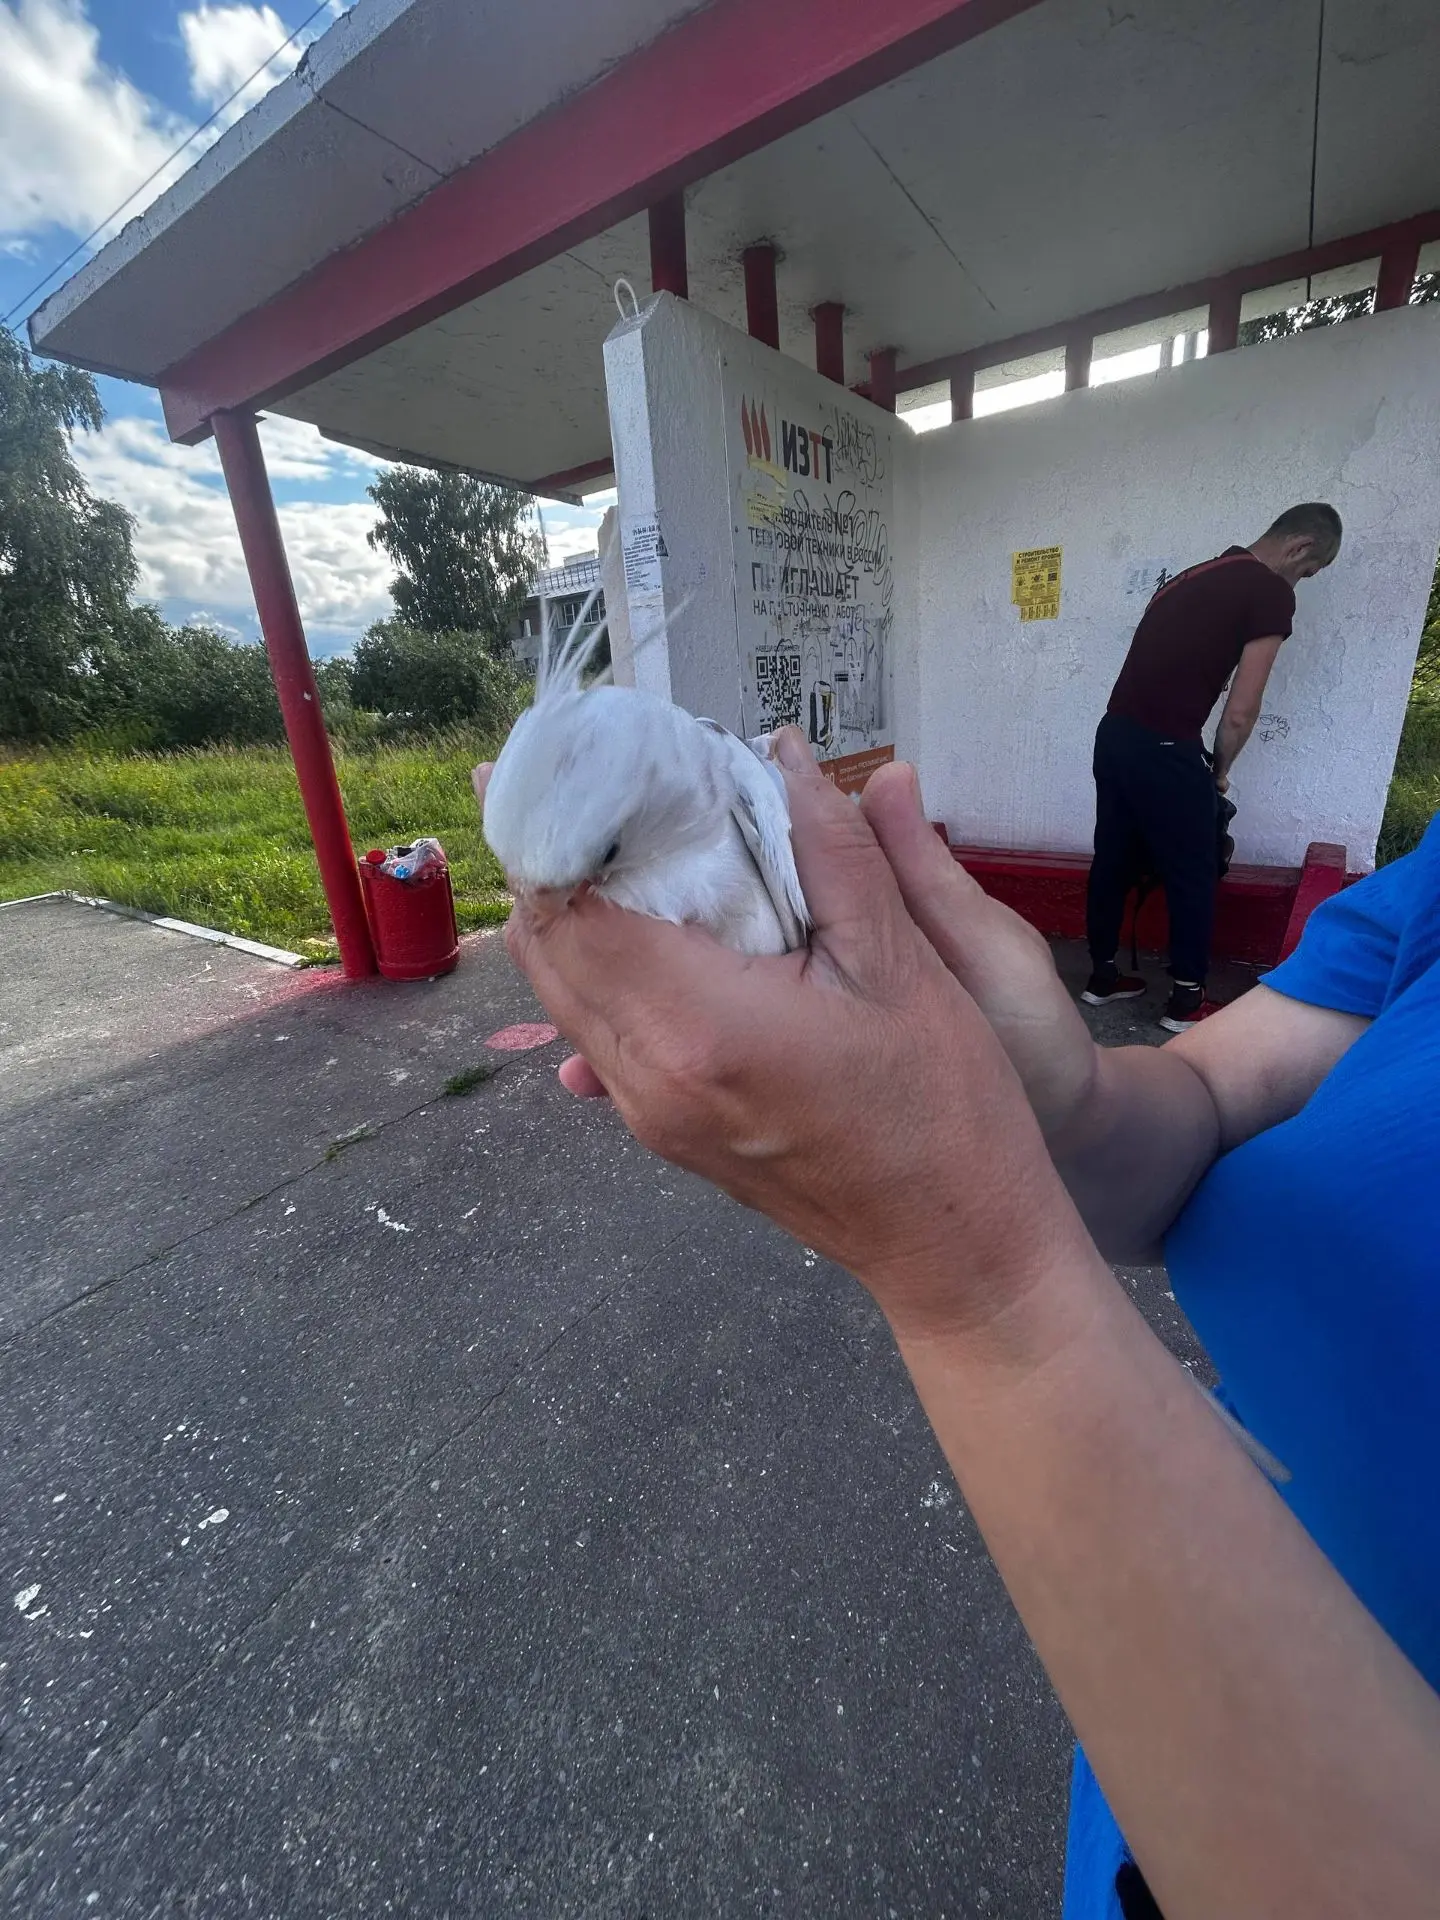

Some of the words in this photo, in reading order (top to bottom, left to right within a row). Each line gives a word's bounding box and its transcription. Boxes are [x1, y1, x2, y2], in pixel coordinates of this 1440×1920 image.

[782, 419, 834, 484] ИЗТТ
[806, 537, 845, 559] ТЕХНИКИ
[753, 599, 768, 616] НА
[769, 600, 830, 619] ПСТОЯННУЮ
